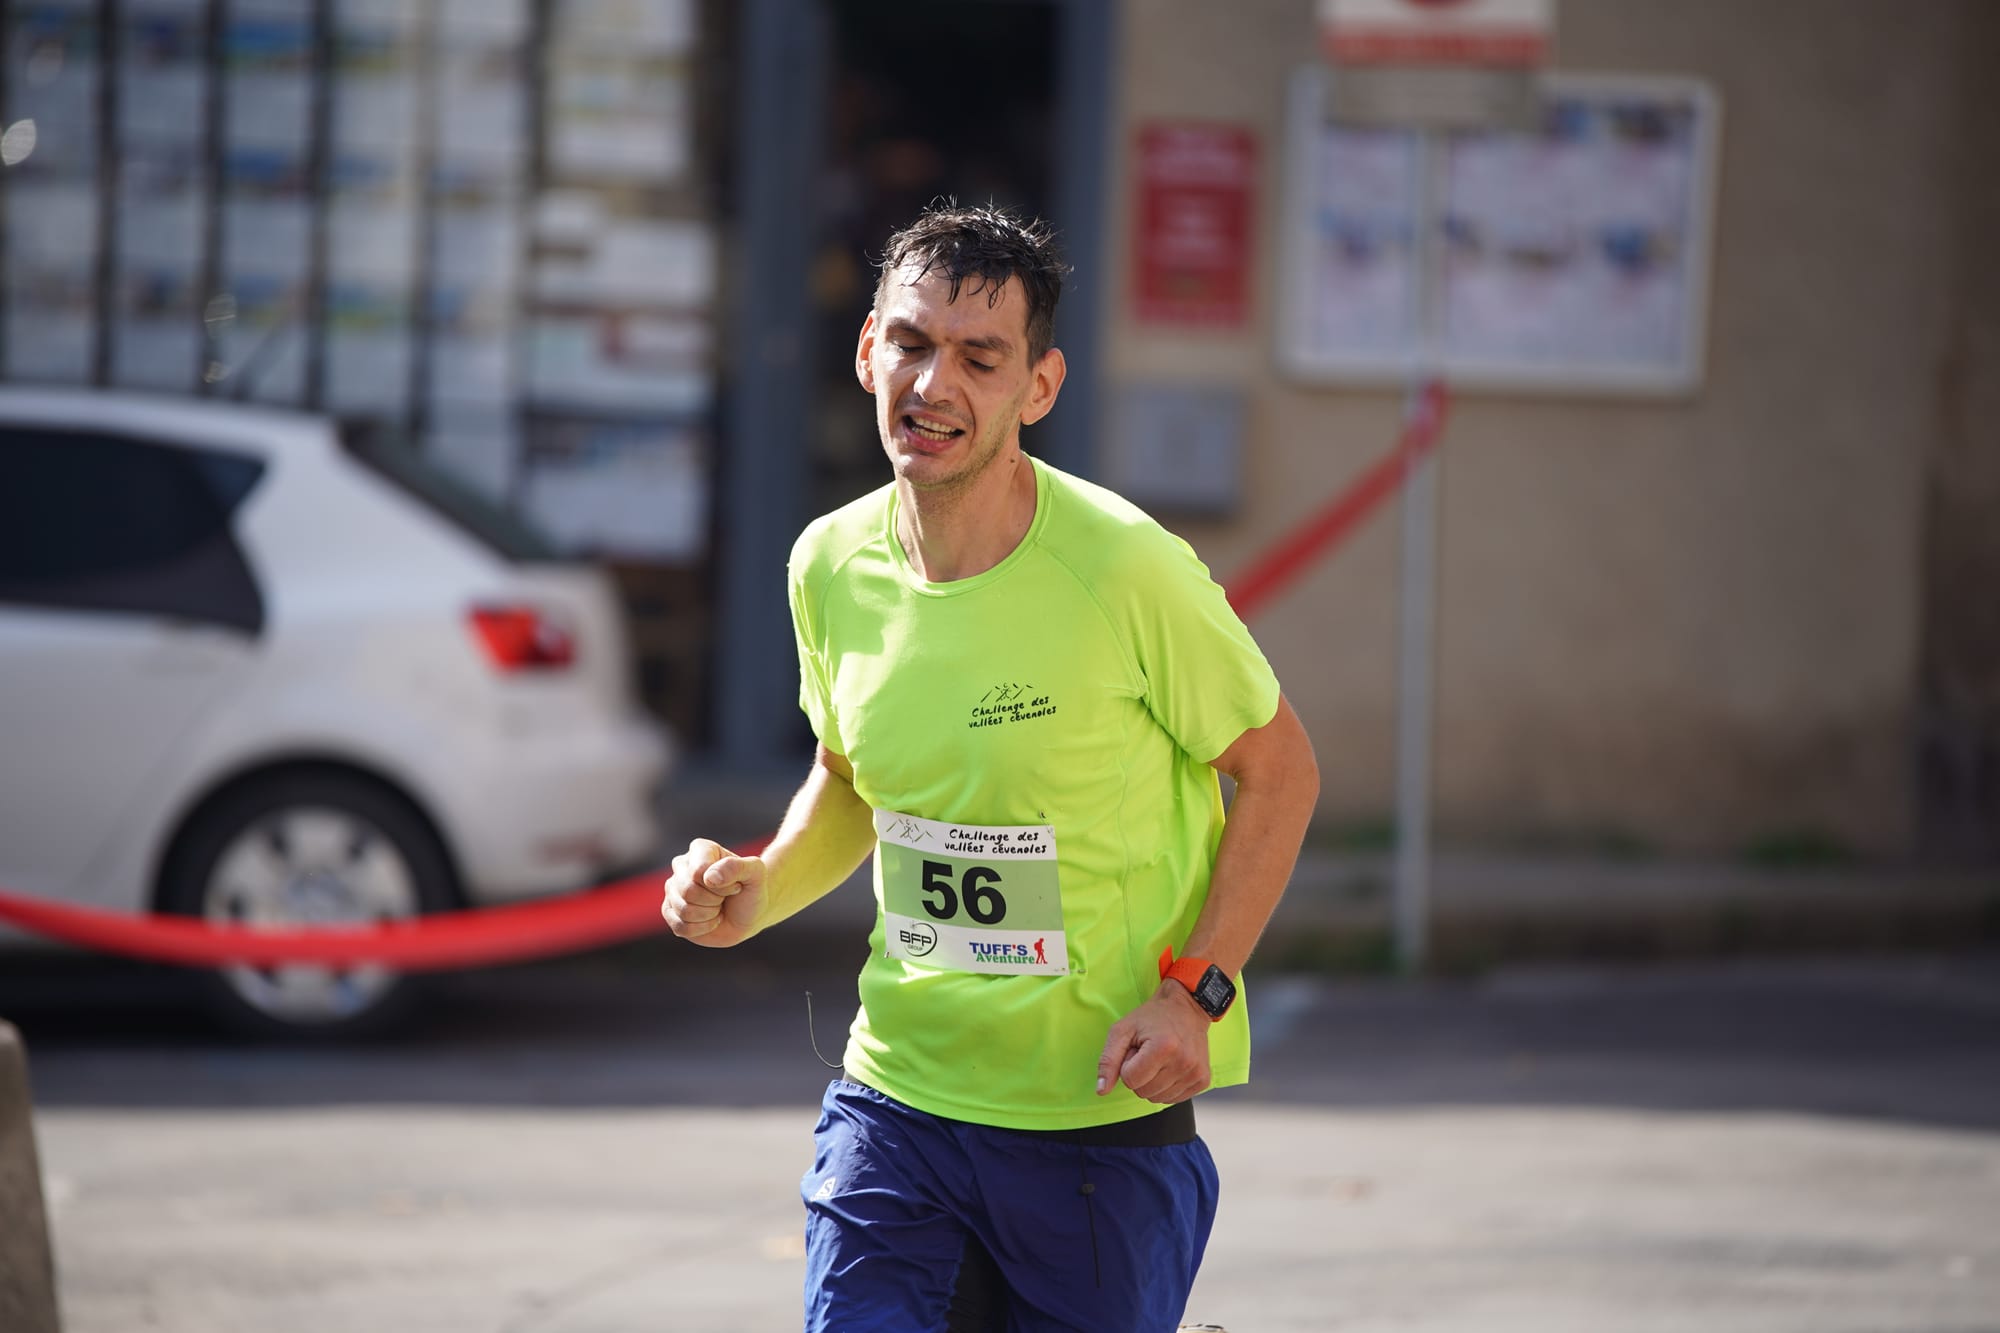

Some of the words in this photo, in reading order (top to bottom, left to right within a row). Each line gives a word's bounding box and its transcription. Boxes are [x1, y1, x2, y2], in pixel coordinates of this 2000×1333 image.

[972, 702, 1024, 717] Challenge
[1031, 696, 1049, 707] des
[968, 716, 1003, 728] vallées
[949, 829, 1009, 845] Challenge
[1017, 832, 1039, 841] des
[944, 841, 984, 853] vallées
[921, 860, 1007, 925] 56
[900, 930, 932, 947] BFP
[969, 942, 1028, 956] TUFF'S
[976, 953, 1035, 964] Aventure
